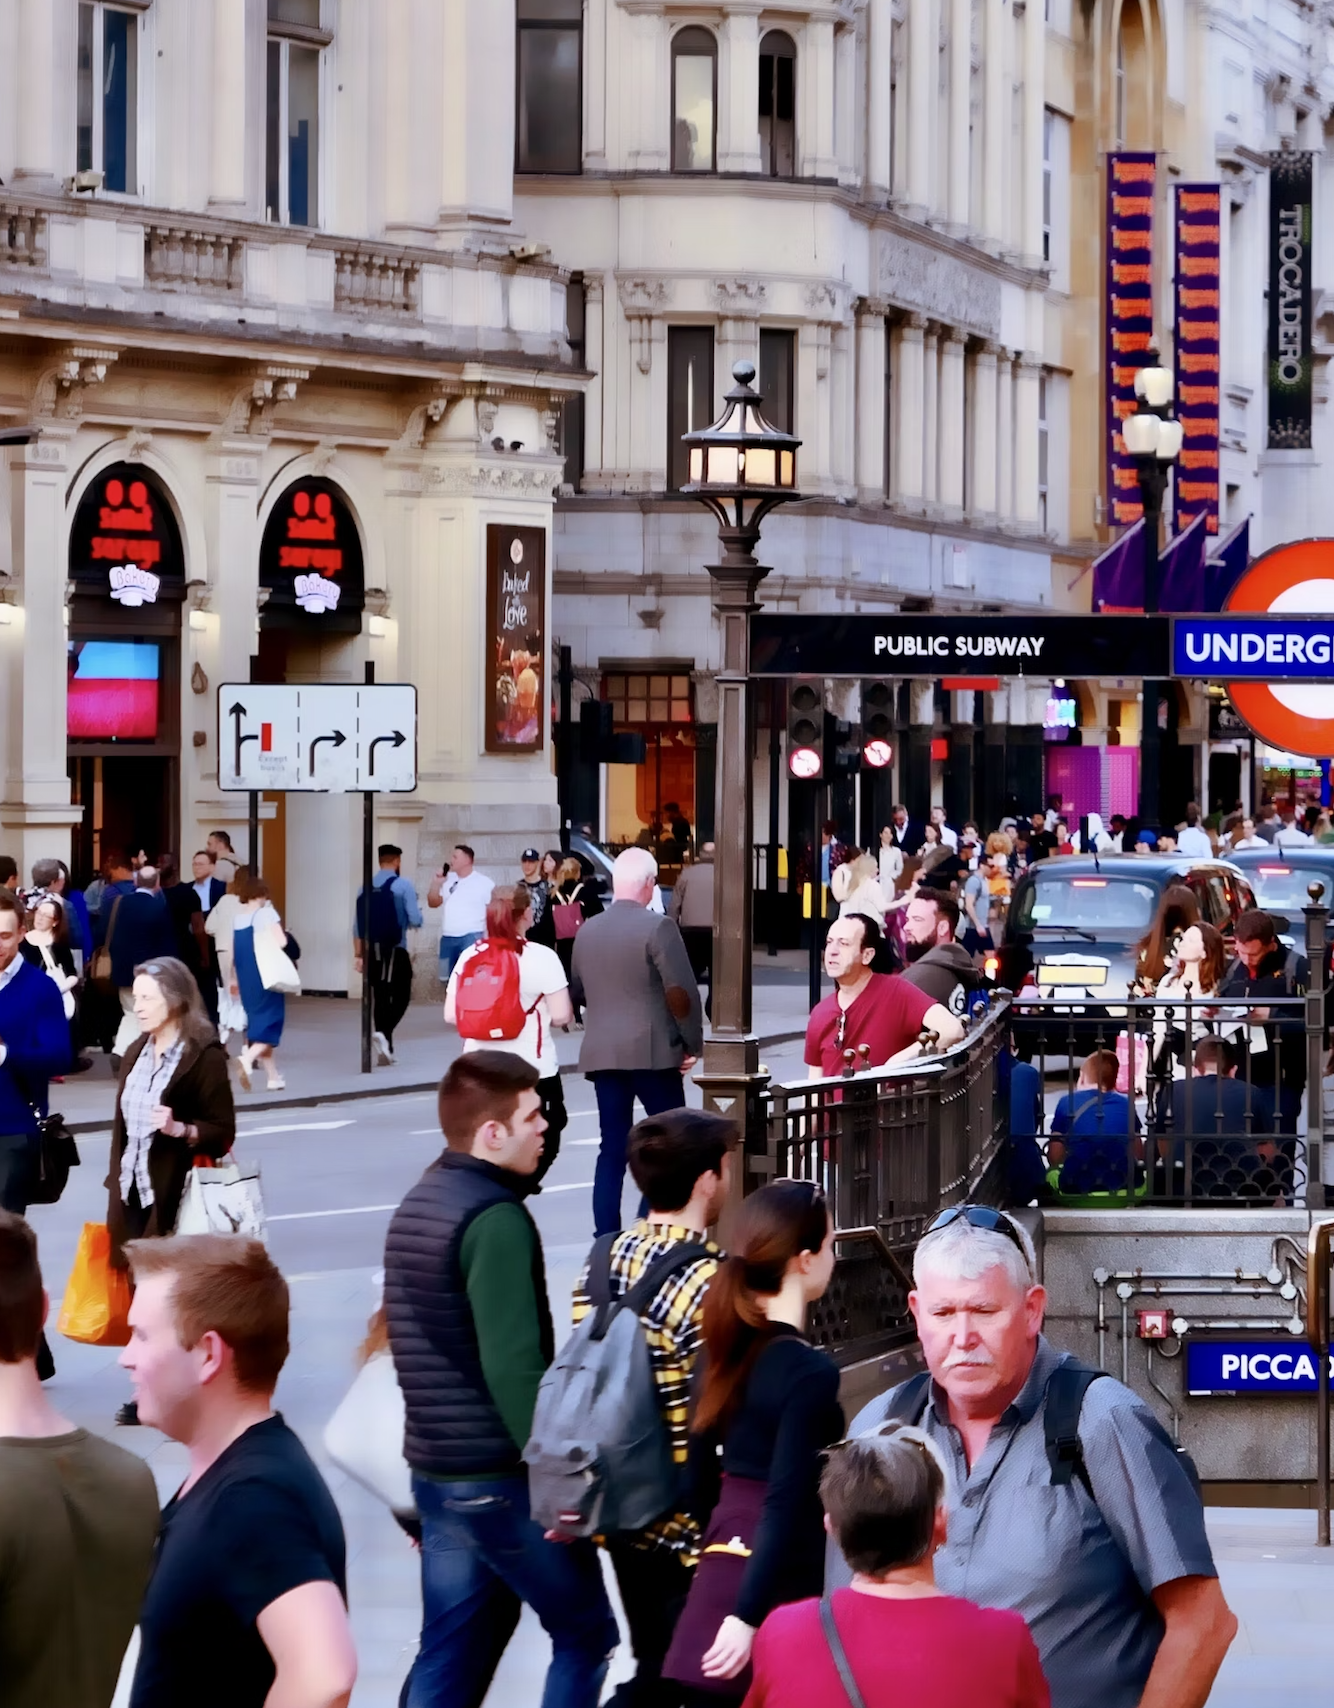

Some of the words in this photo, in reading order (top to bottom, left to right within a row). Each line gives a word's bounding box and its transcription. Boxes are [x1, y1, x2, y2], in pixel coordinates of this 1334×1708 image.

[1278, 203, 1303, 385] TROCADERO
[503, 596, 528, 630] Love
[874, 635, 950, 657] PUBLIC
[954, 636, 1045, 657] SUBWAY
